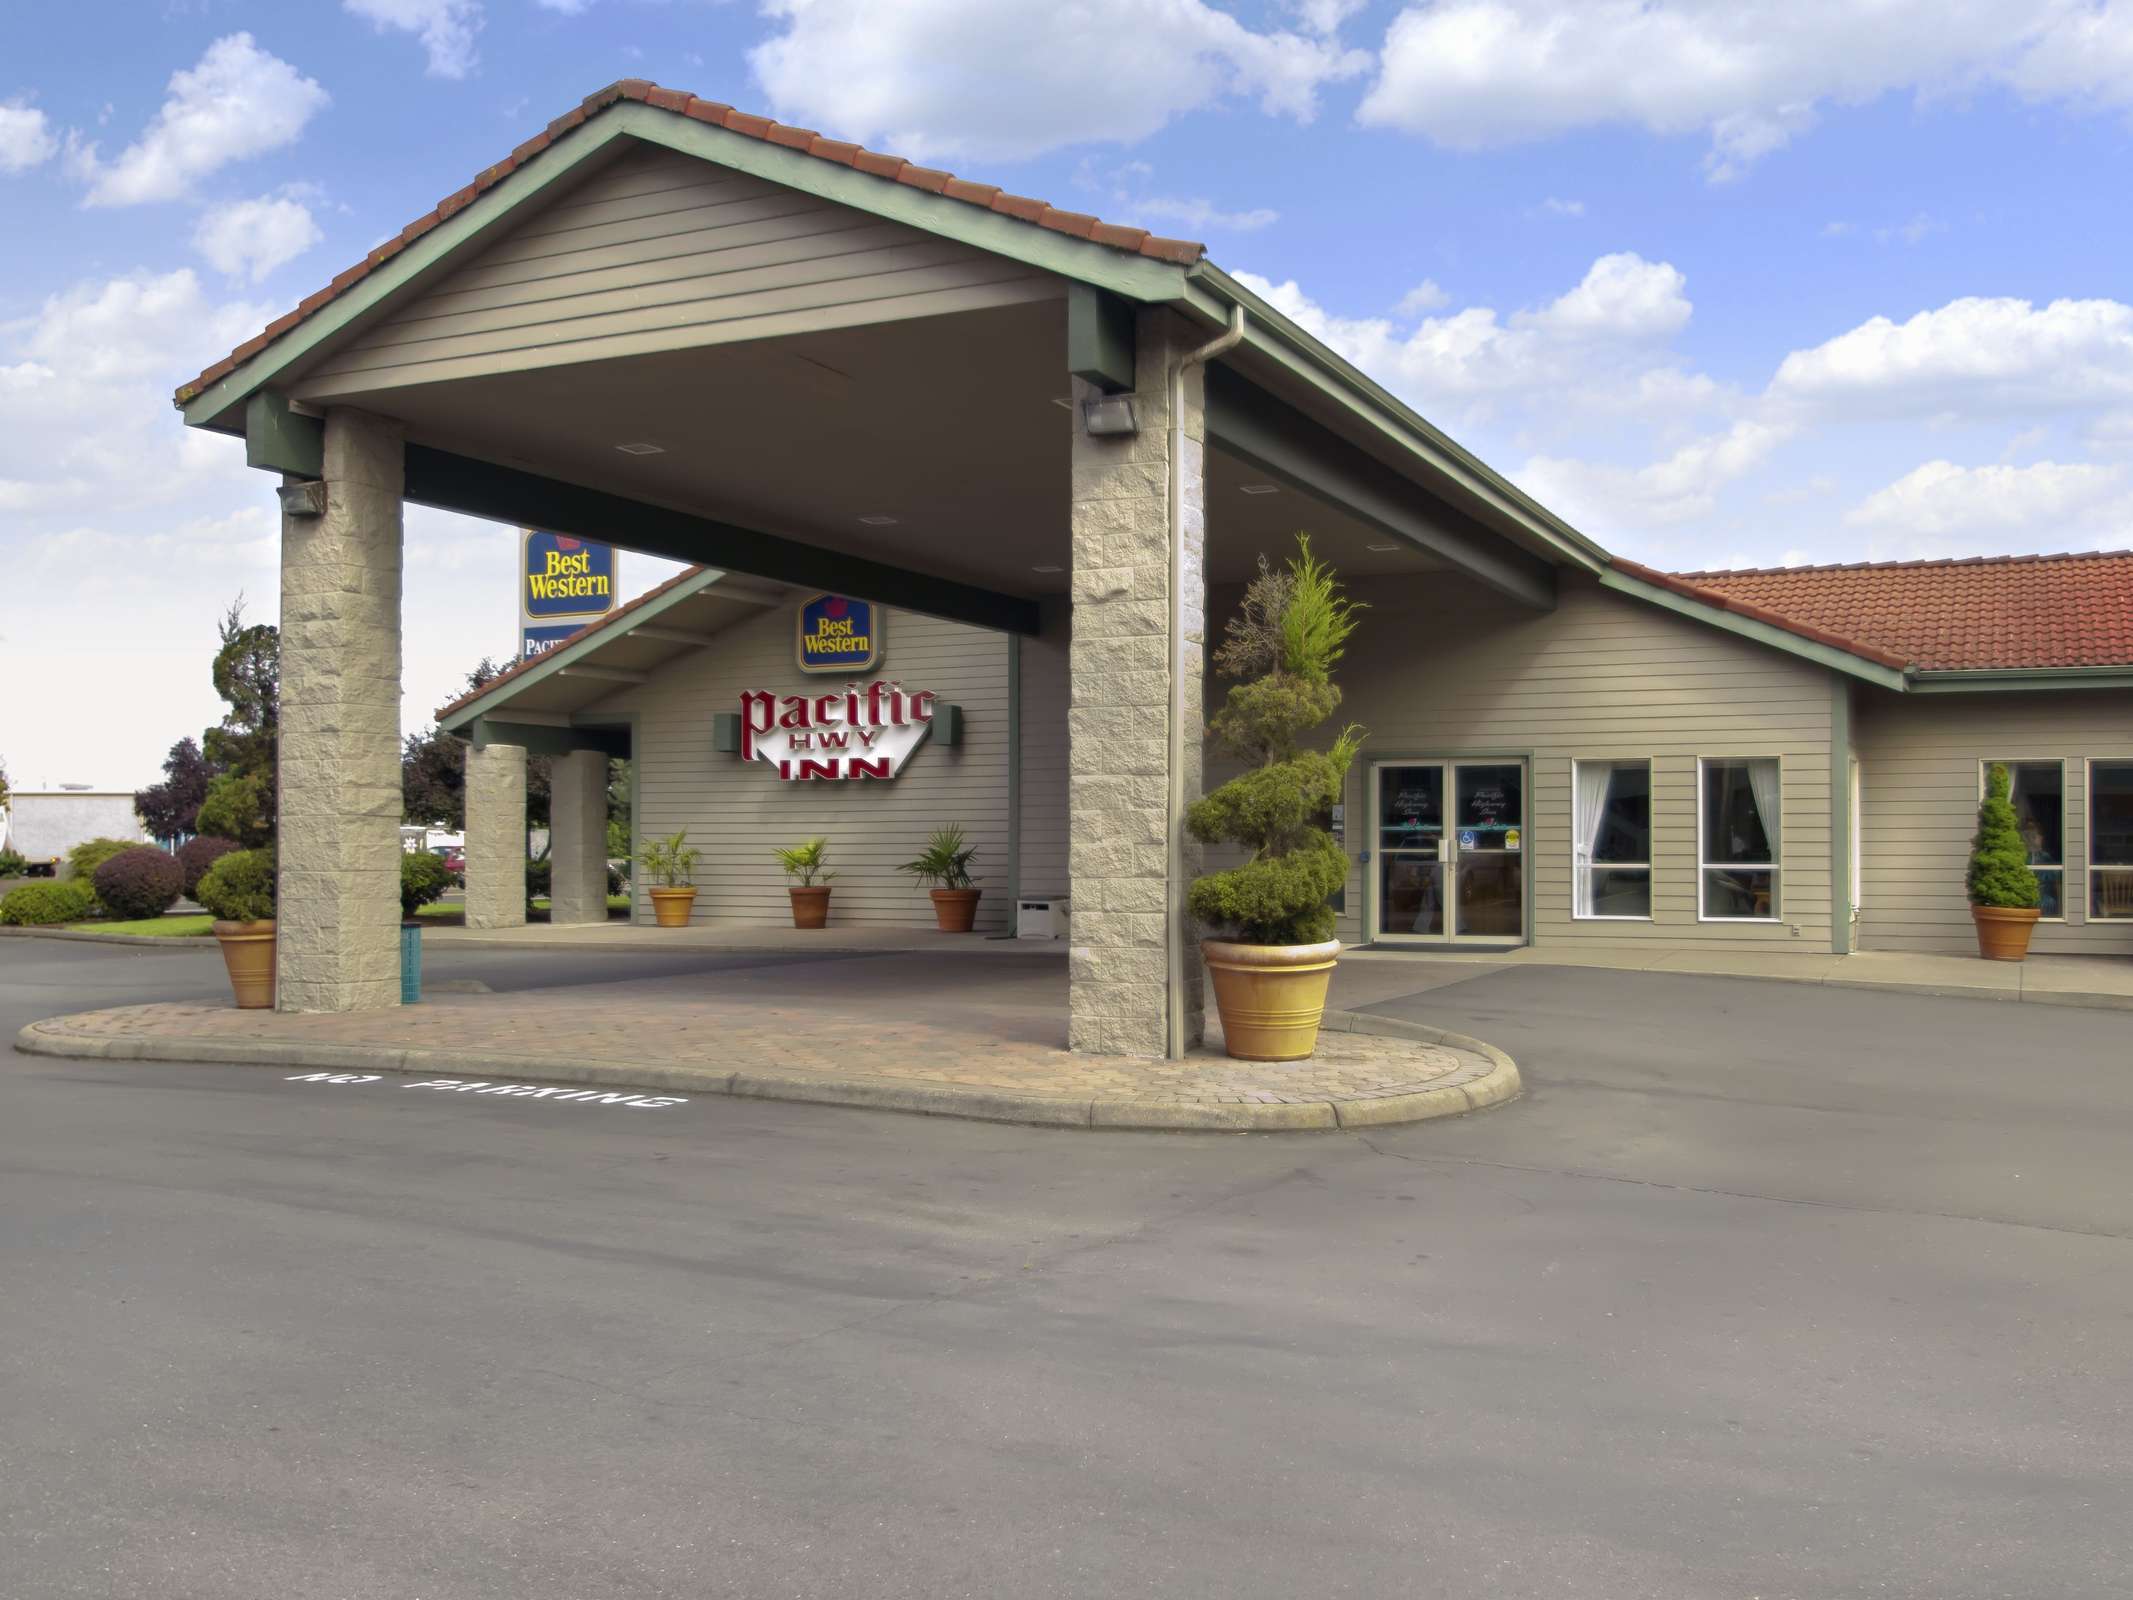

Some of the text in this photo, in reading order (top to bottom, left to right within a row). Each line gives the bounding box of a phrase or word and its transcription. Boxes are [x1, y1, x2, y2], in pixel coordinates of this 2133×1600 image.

[545, 549, 590, 576] Best
[529, 569, 610, 600] Western
[817, 616, 854, 638] Best
[804, 634, 870, 654] Western
[789, 730, 876, 749] HWY
[779, 757, 892, 780] INN
[284, 1072, 689, 1107] NO PARKING
